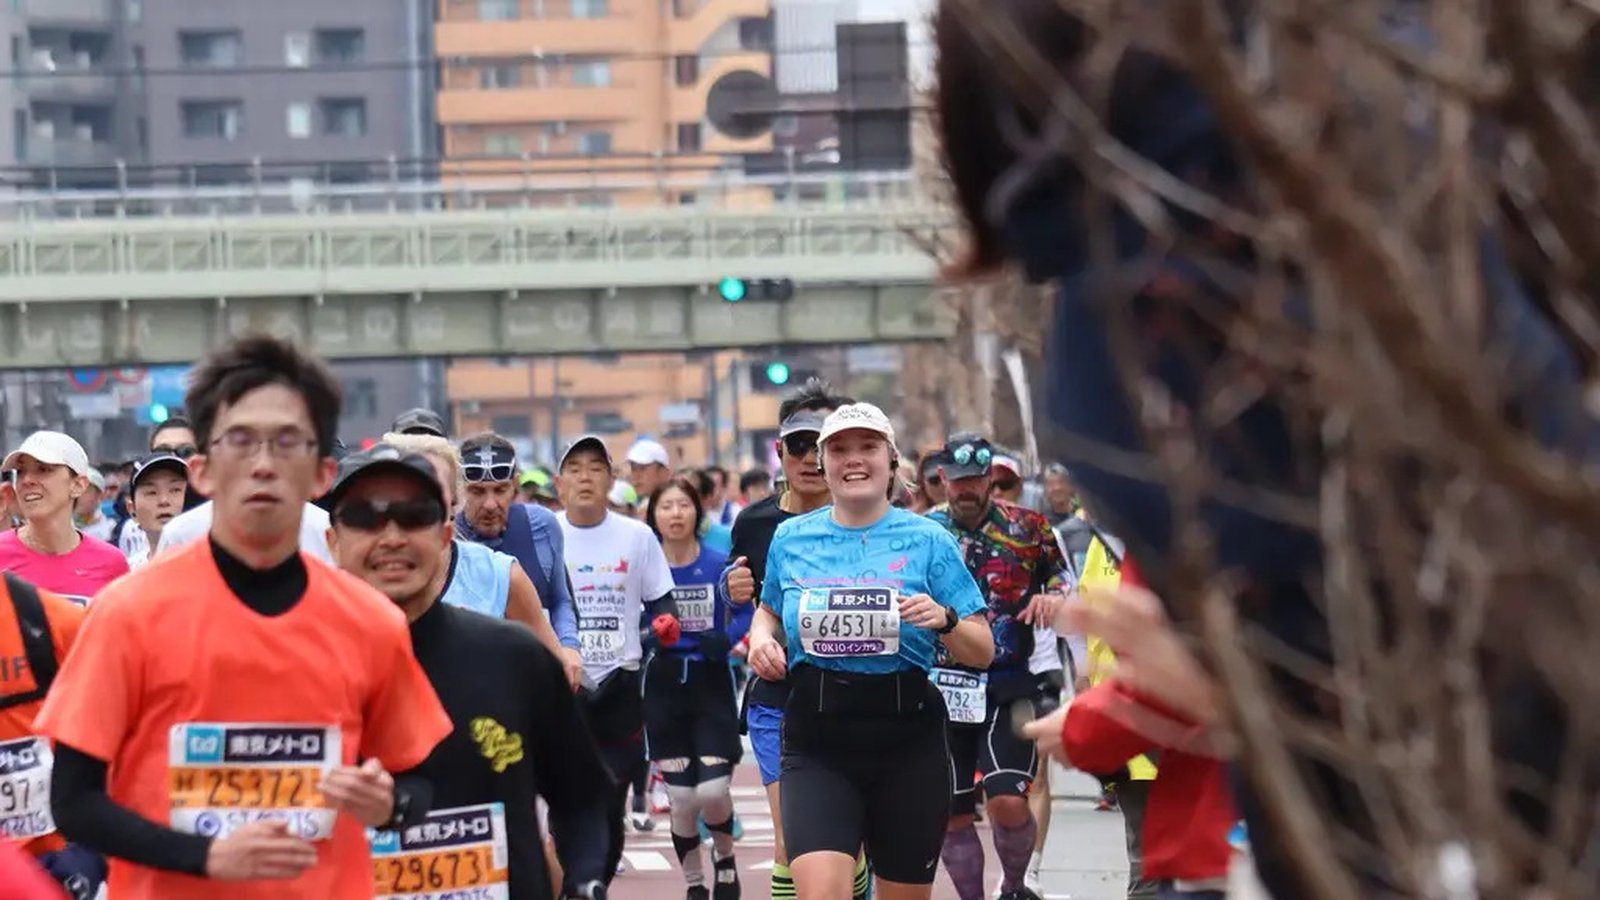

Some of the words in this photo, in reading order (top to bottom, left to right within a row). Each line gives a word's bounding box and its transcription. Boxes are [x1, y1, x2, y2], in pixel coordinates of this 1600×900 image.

[831, 594, 887, 606] 東京メトロ
[801, 617, 812, 629] G
[818, 614, 873, 638] 64531
[941, 690, 970, 708] 792
[230, 735, 320, 756] 東京メトロ
[207, 769, 304, 806] 25372
[404, 816, 490, 844] 東京メトロ
[390, 850, 482, 892] 29673
